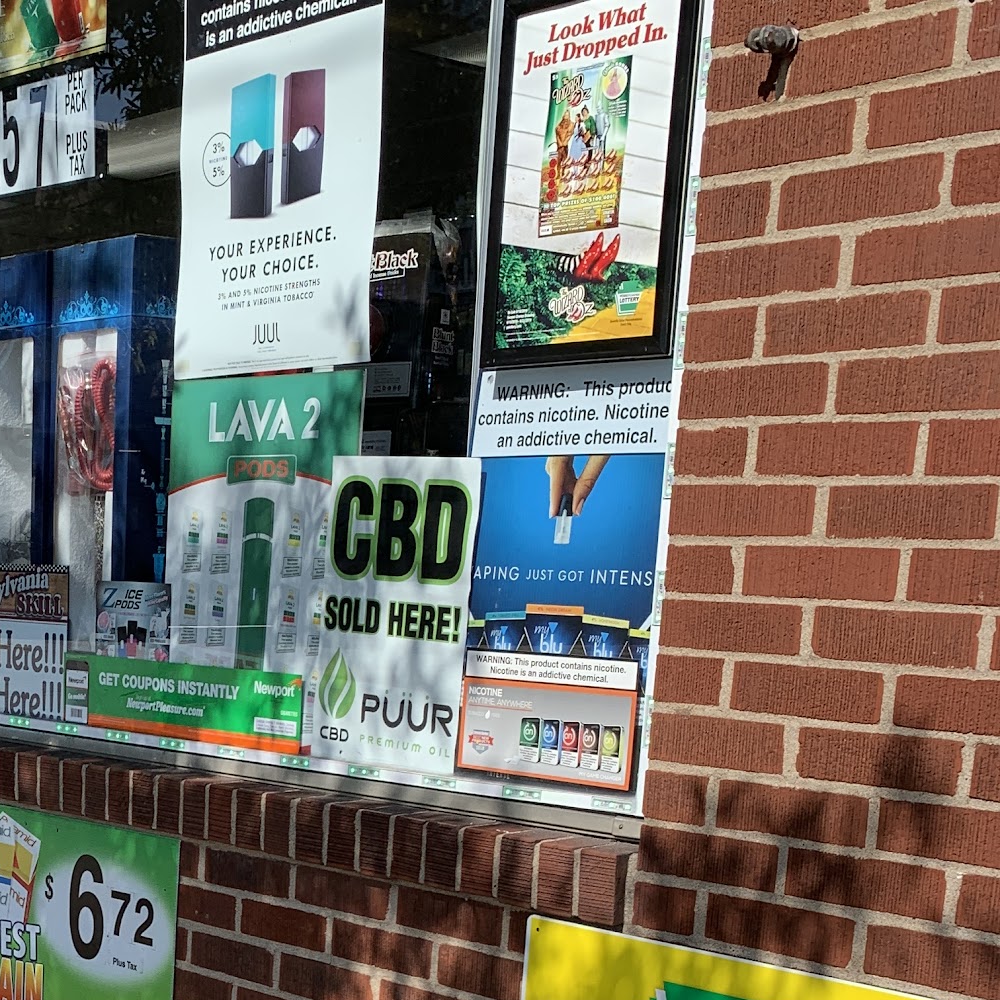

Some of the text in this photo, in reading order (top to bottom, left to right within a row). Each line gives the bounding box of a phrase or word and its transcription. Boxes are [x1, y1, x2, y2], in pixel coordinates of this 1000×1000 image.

[206, 10, 293, 47] is an addictive
[548, 3, 647, 43] Look What
[523, 22, 668, 75] Just Dropped In.
[67, 71, 84, 92] PER
[65, 90, 87, 115] PACK
[66, 130, 88, 155] PLUS
[69, 153, 86, 176] TAX
[212, 165, 225, 178] 5%
[209, 226, 337, 261] YOUR EXPERIENCE.
[222, 254, 319, 283] YOUR CHOICE.
[375, 249, 418, 271] Black
[228, 278, 321, 299] AND NICOTINE STRENGTHS
[230, 292, 314, 310] MINT VIRGINIA TOBACCO
[252, 322, 280, 345] JUUL
[497, 383, 570, 402] WARNING:
[583, 379, 614, 397] This
[208, 397, 321, 443] LAVA 2
[478, 403, 670, 426] contains nicotine. Nicotine
[497, 427, 657, 448] an addictive chemical.
[234, 460, 289, 479] PODS
[330, 475, 473, 586] CBD
[525, 569, 554, 581] JUST
[557, 570, 584, 582] GOT
[16, 592, 64, 618] SKILL
[114, 600, 142, 610] PODS
[125, 589, 144, 600] ICE
[324, 594, 462, 645] SOLD HERE!
[476, 654, 627, 674] WARNING: This product contains nicotine.
[490, 666, 609, 684] Nicotine is an addictive chemical.
[98, 672, 240, 700] GET COUPONS INSTANTLY
[254, 680, 295, 698] Newport
[469, 686, 503, 697] NICOTINE
[496, 698, 533, 709] ANYWHERE
[319, 725, 349, 742] CBD
[359, 734, 450, 758] PREMIUM OIL
[44, 872, 54, 902] $
[112, 957, 137, 971] Plus Tax
